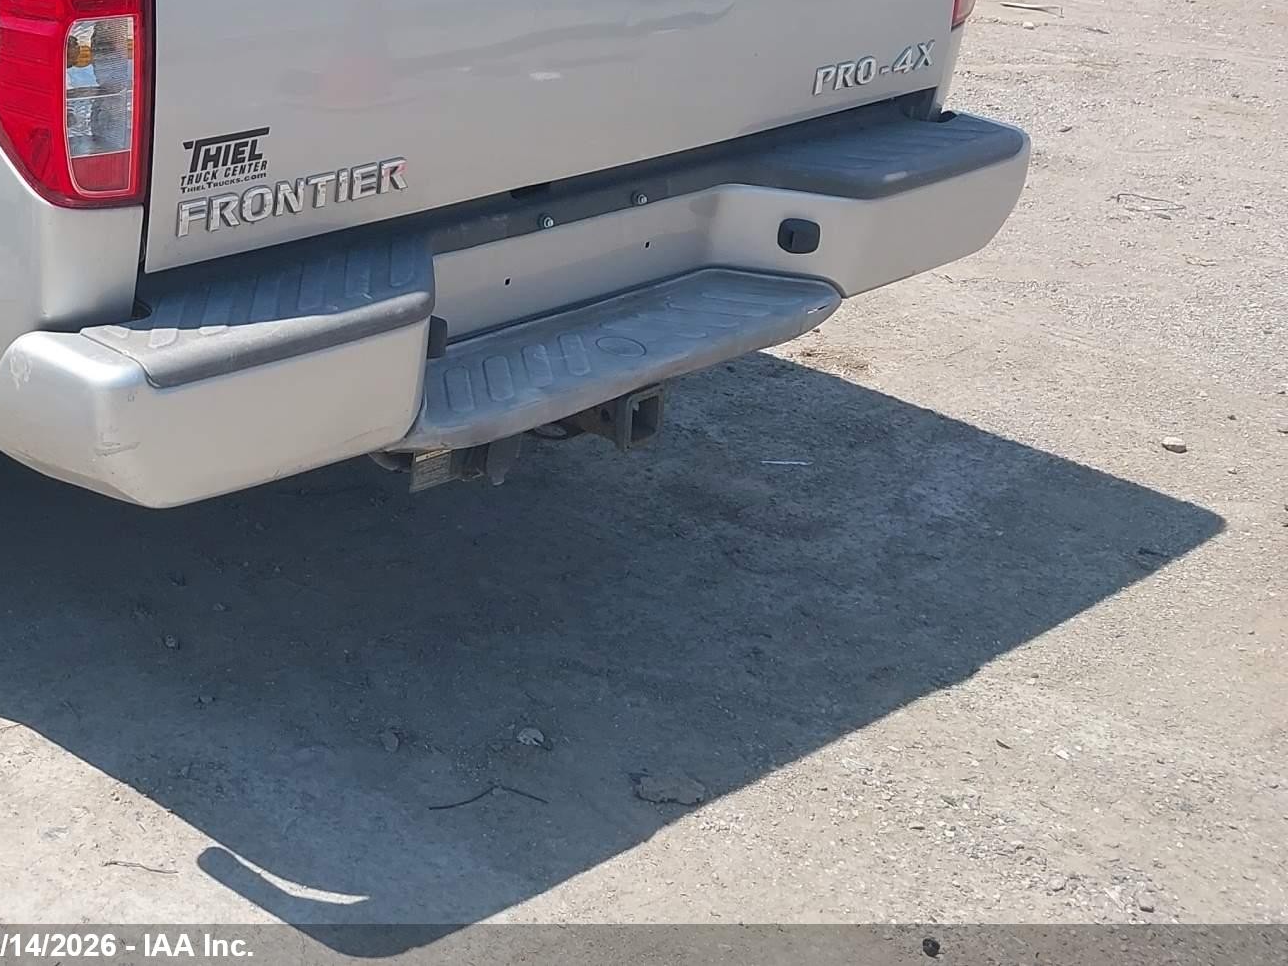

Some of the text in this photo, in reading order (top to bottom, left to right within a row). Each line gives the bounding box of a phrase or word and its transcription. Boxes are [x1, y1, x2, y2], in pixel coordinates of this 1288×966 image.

[812, 40, 935, 96] PRO-4X
[181, 160, 268, 187] TRUCK CENTER
[183, 127, 270, 173] THIEL
[176, 156, 409, 238] FRONTIER
